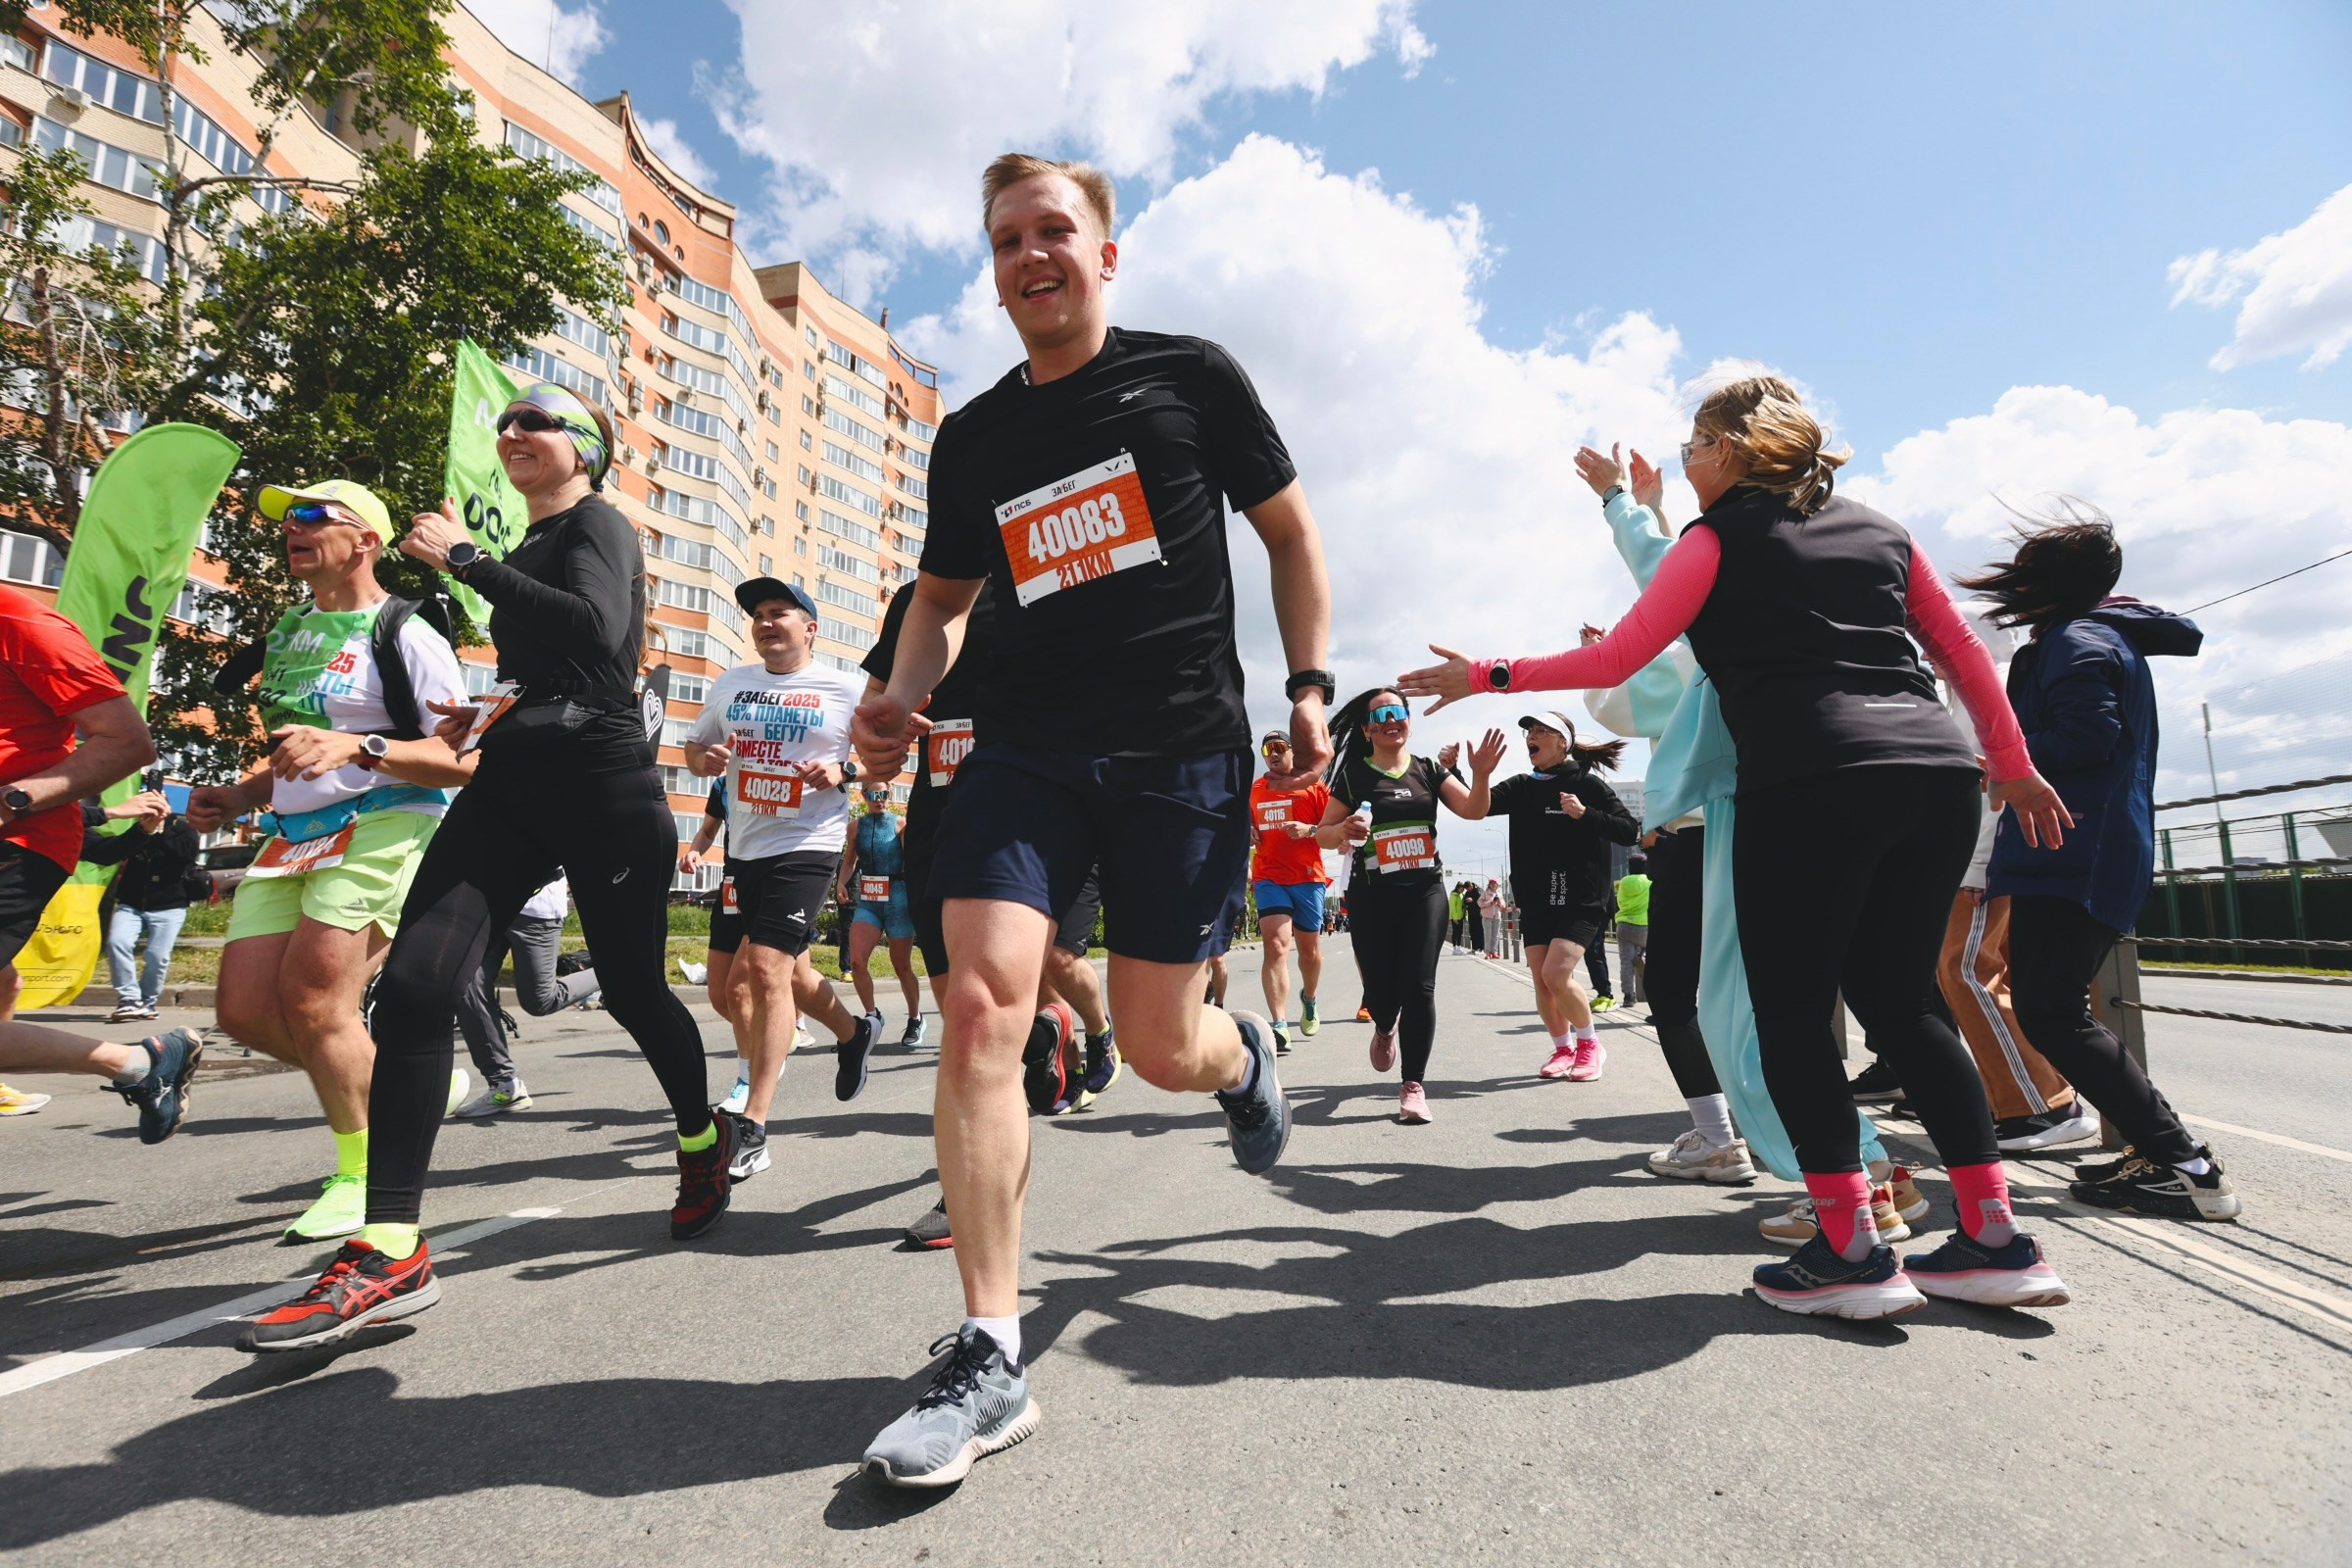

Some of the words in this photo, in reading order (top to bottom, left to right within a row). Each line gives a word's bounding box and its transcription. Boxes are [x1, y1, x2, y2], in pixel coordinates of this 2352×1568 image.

[1013, 498, 1032, 513] ПСБ
[1028, 492, 1126, 564] 40083
[733, 690, 821, 709] #ЗАБЕГ2025
[725, 704, 752, 722] 45%
[754, 705, 825, 728] ПЛАНЕТЫ
[764, 722, 808, 744] БЕГУТ
[736, 739, 783, 760] ВМЕСТЕ
[939, 737, 976, 766] 401
[745, 776, 792, 804] 40028
[1264, 808, 1286, 821] 40115
[279, 836, 338, 862] 40124
[1386, 837, 1426, 859] 40098
[1550, 869, 1559, 893] super.
[1549, 894, 1557, 906] Be
[1557, 895, 1566, 906] Be
